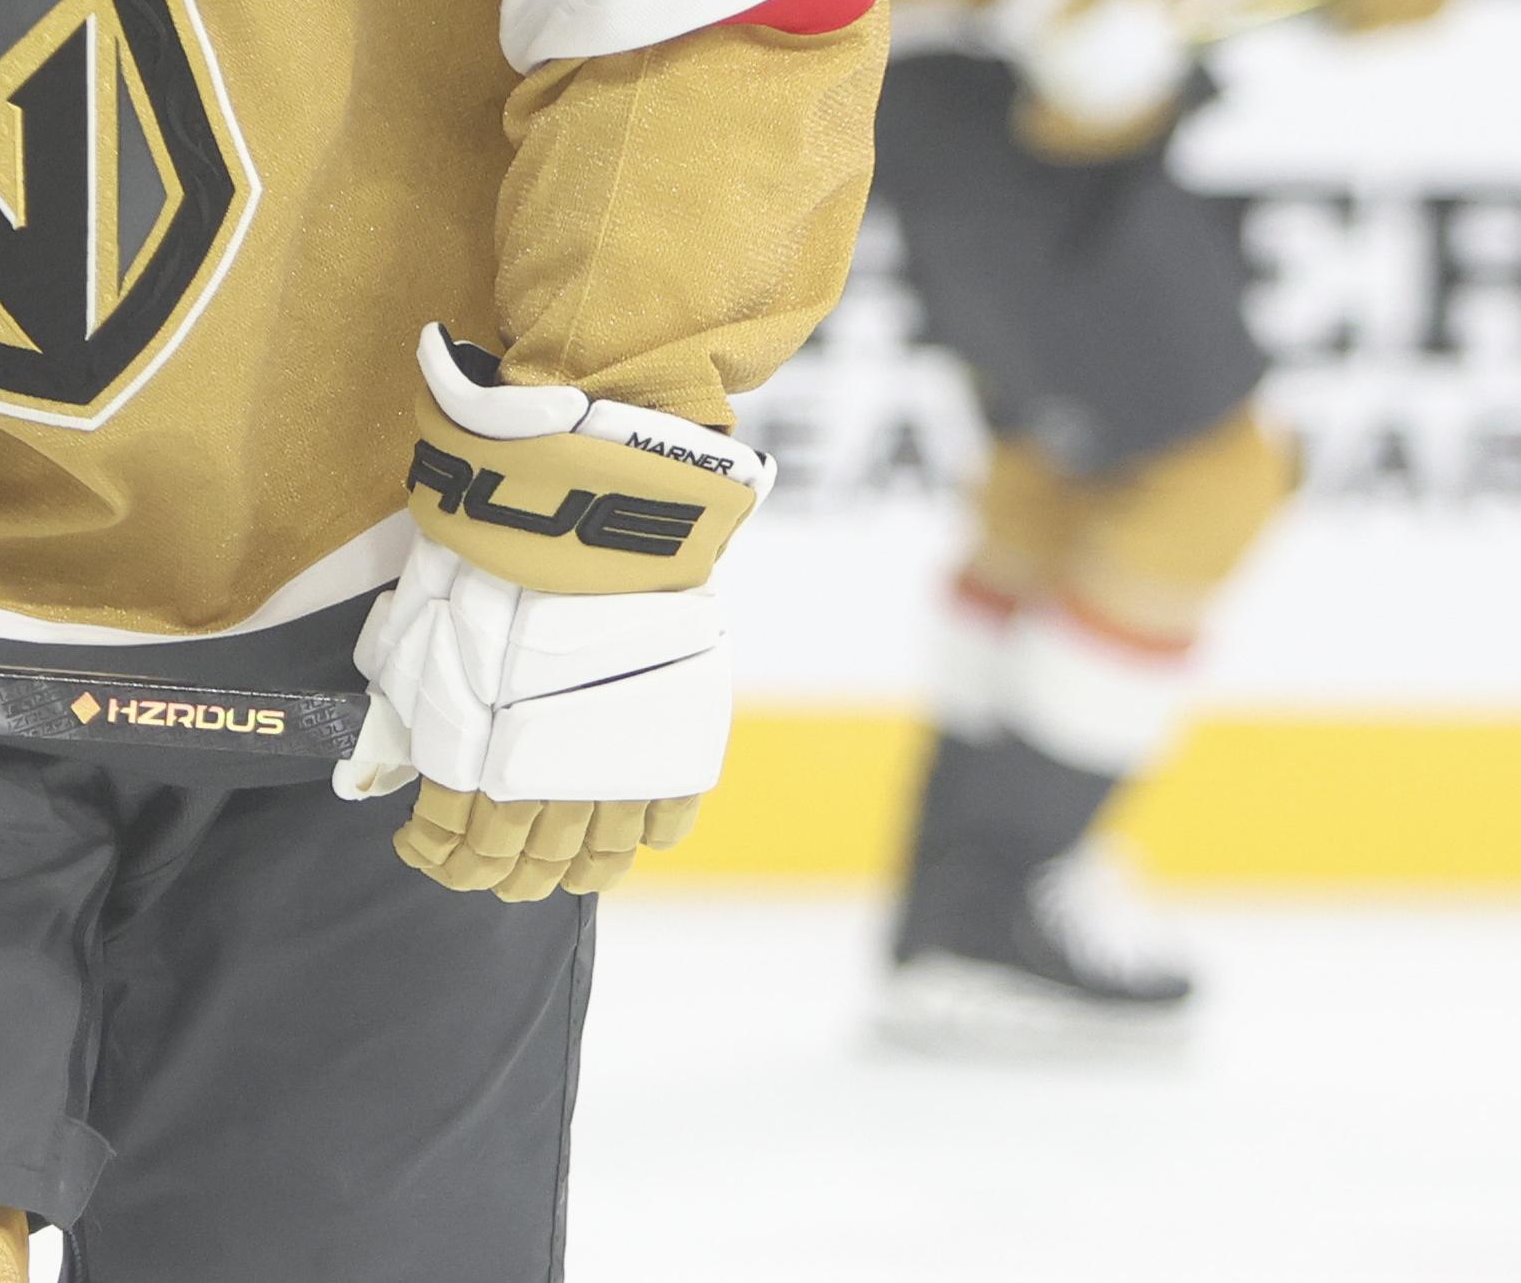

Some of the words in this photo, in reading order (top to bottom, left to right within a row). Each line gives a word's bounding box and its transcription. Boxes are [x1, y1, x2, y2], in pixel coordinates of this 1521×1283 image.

[625, 431, 735, 476] MARNER
[406, 438, 706, 556] RUE
[107, 697, 287, 736] HZRDUS
